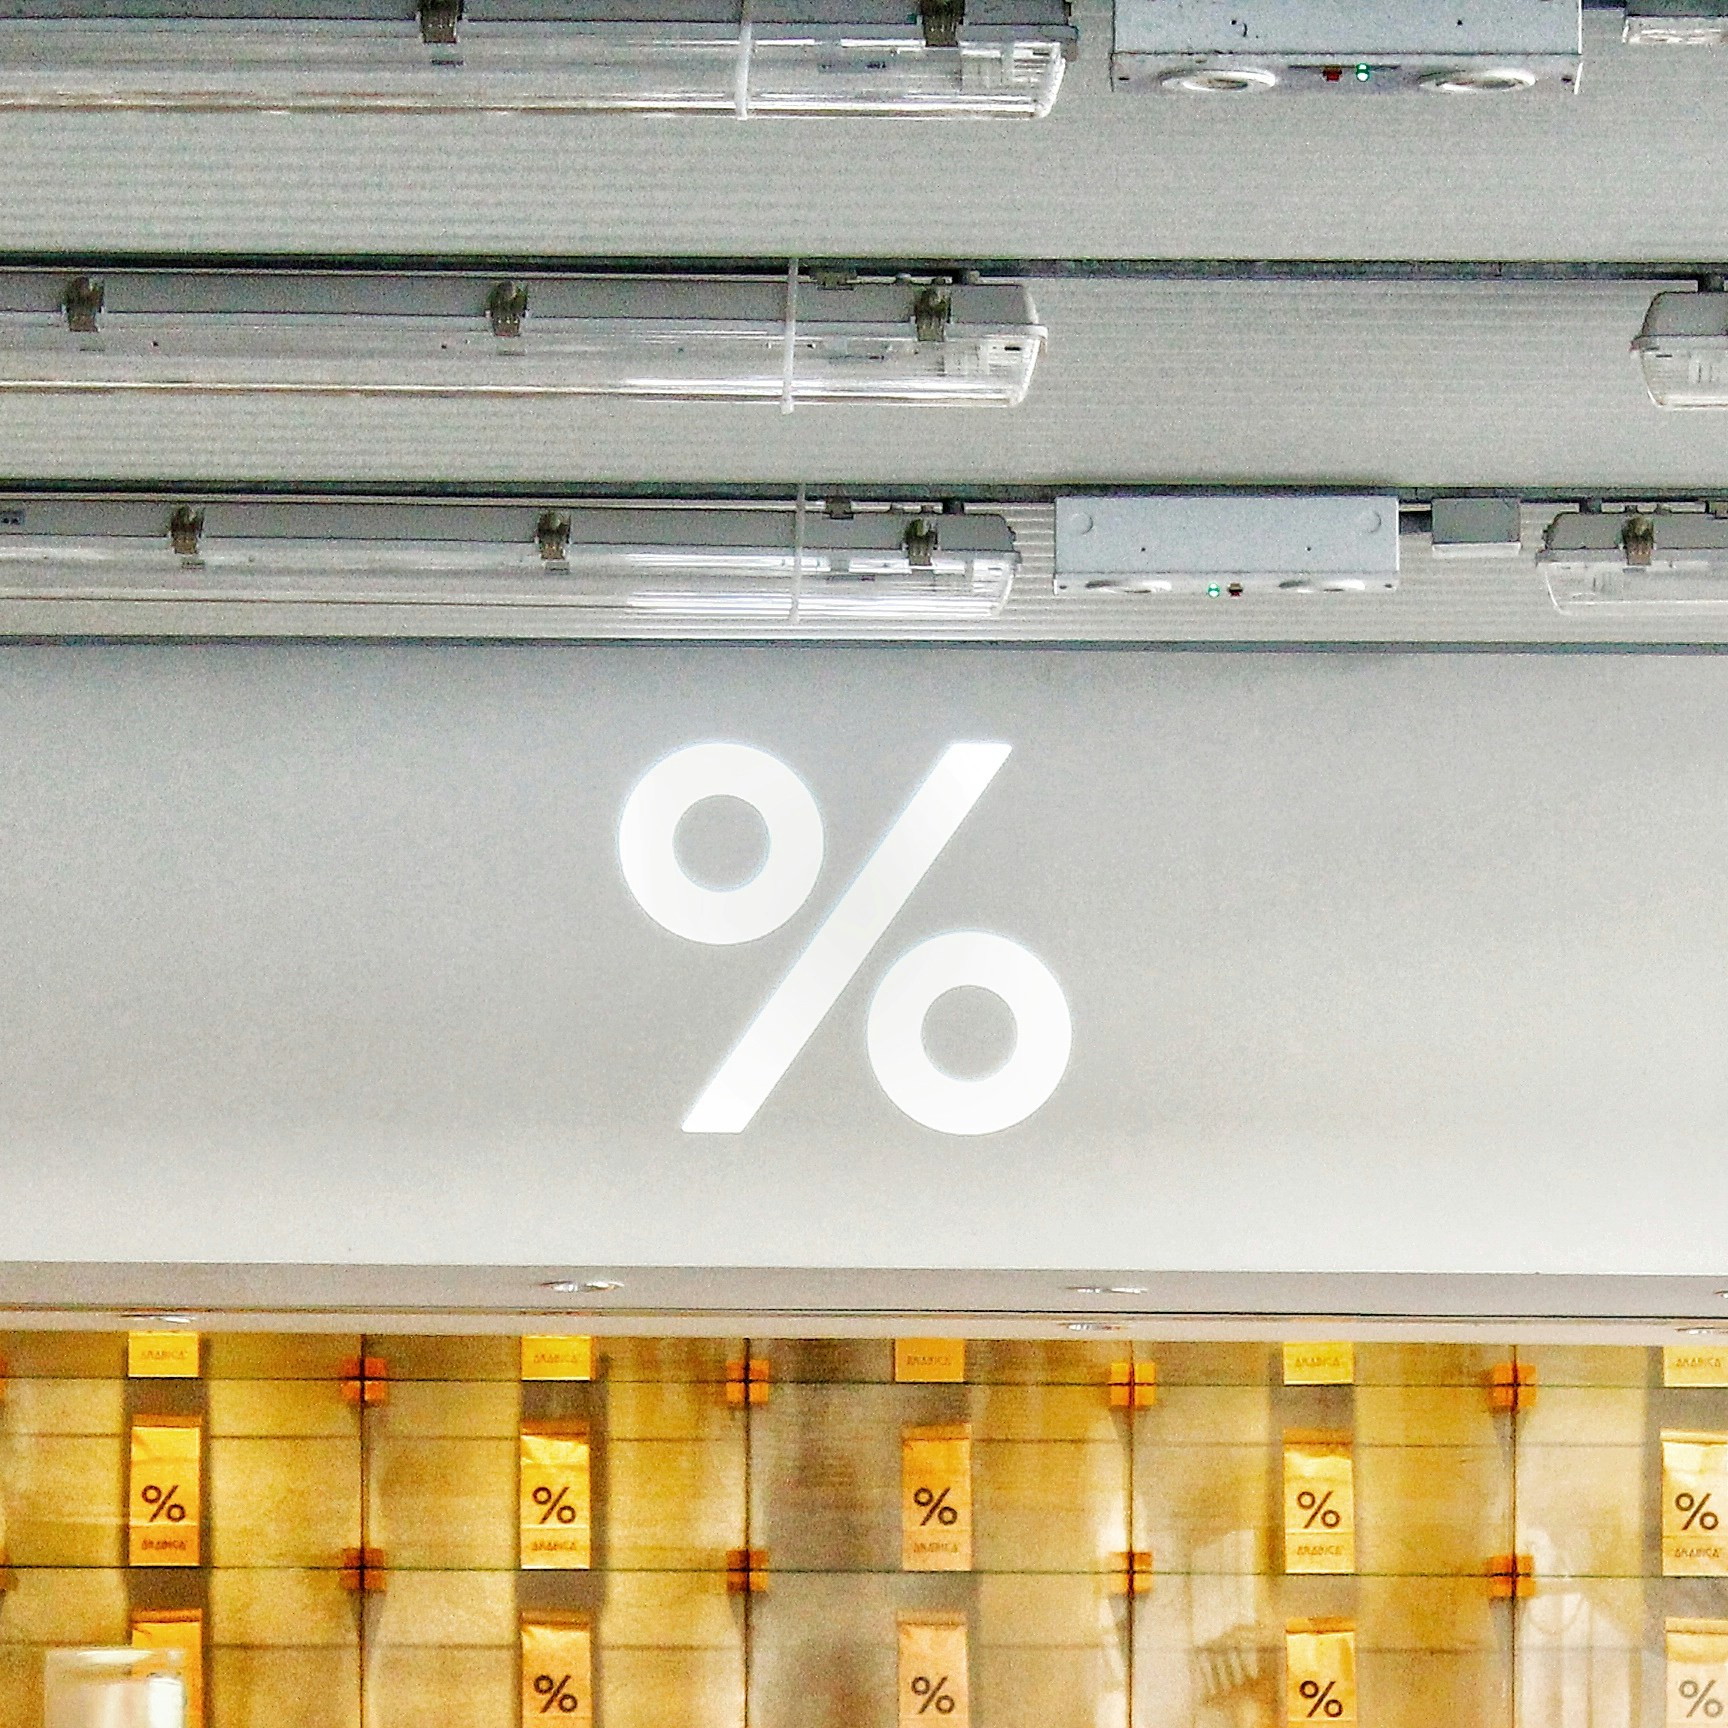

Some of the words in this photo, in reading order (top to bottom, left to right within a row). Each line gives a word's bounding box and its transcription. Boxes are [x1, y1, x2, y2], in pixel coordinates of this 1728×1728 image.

[618, 741, 1073, 1136] %
[142, 1484, 186, 1523] %
[532, 1485, 577, 1524] %
[914, 1486, 959, 1527] %
[1296, 1490, 1341, 1529] %
[1675, 1492, 1720, 1532] %
[533, 1673, 579, 1713] %
[910, 1676, 956, 1715] %
[1299, 1680, 1344, 1719] %
[1678, 1679, 1724, 1719] %
